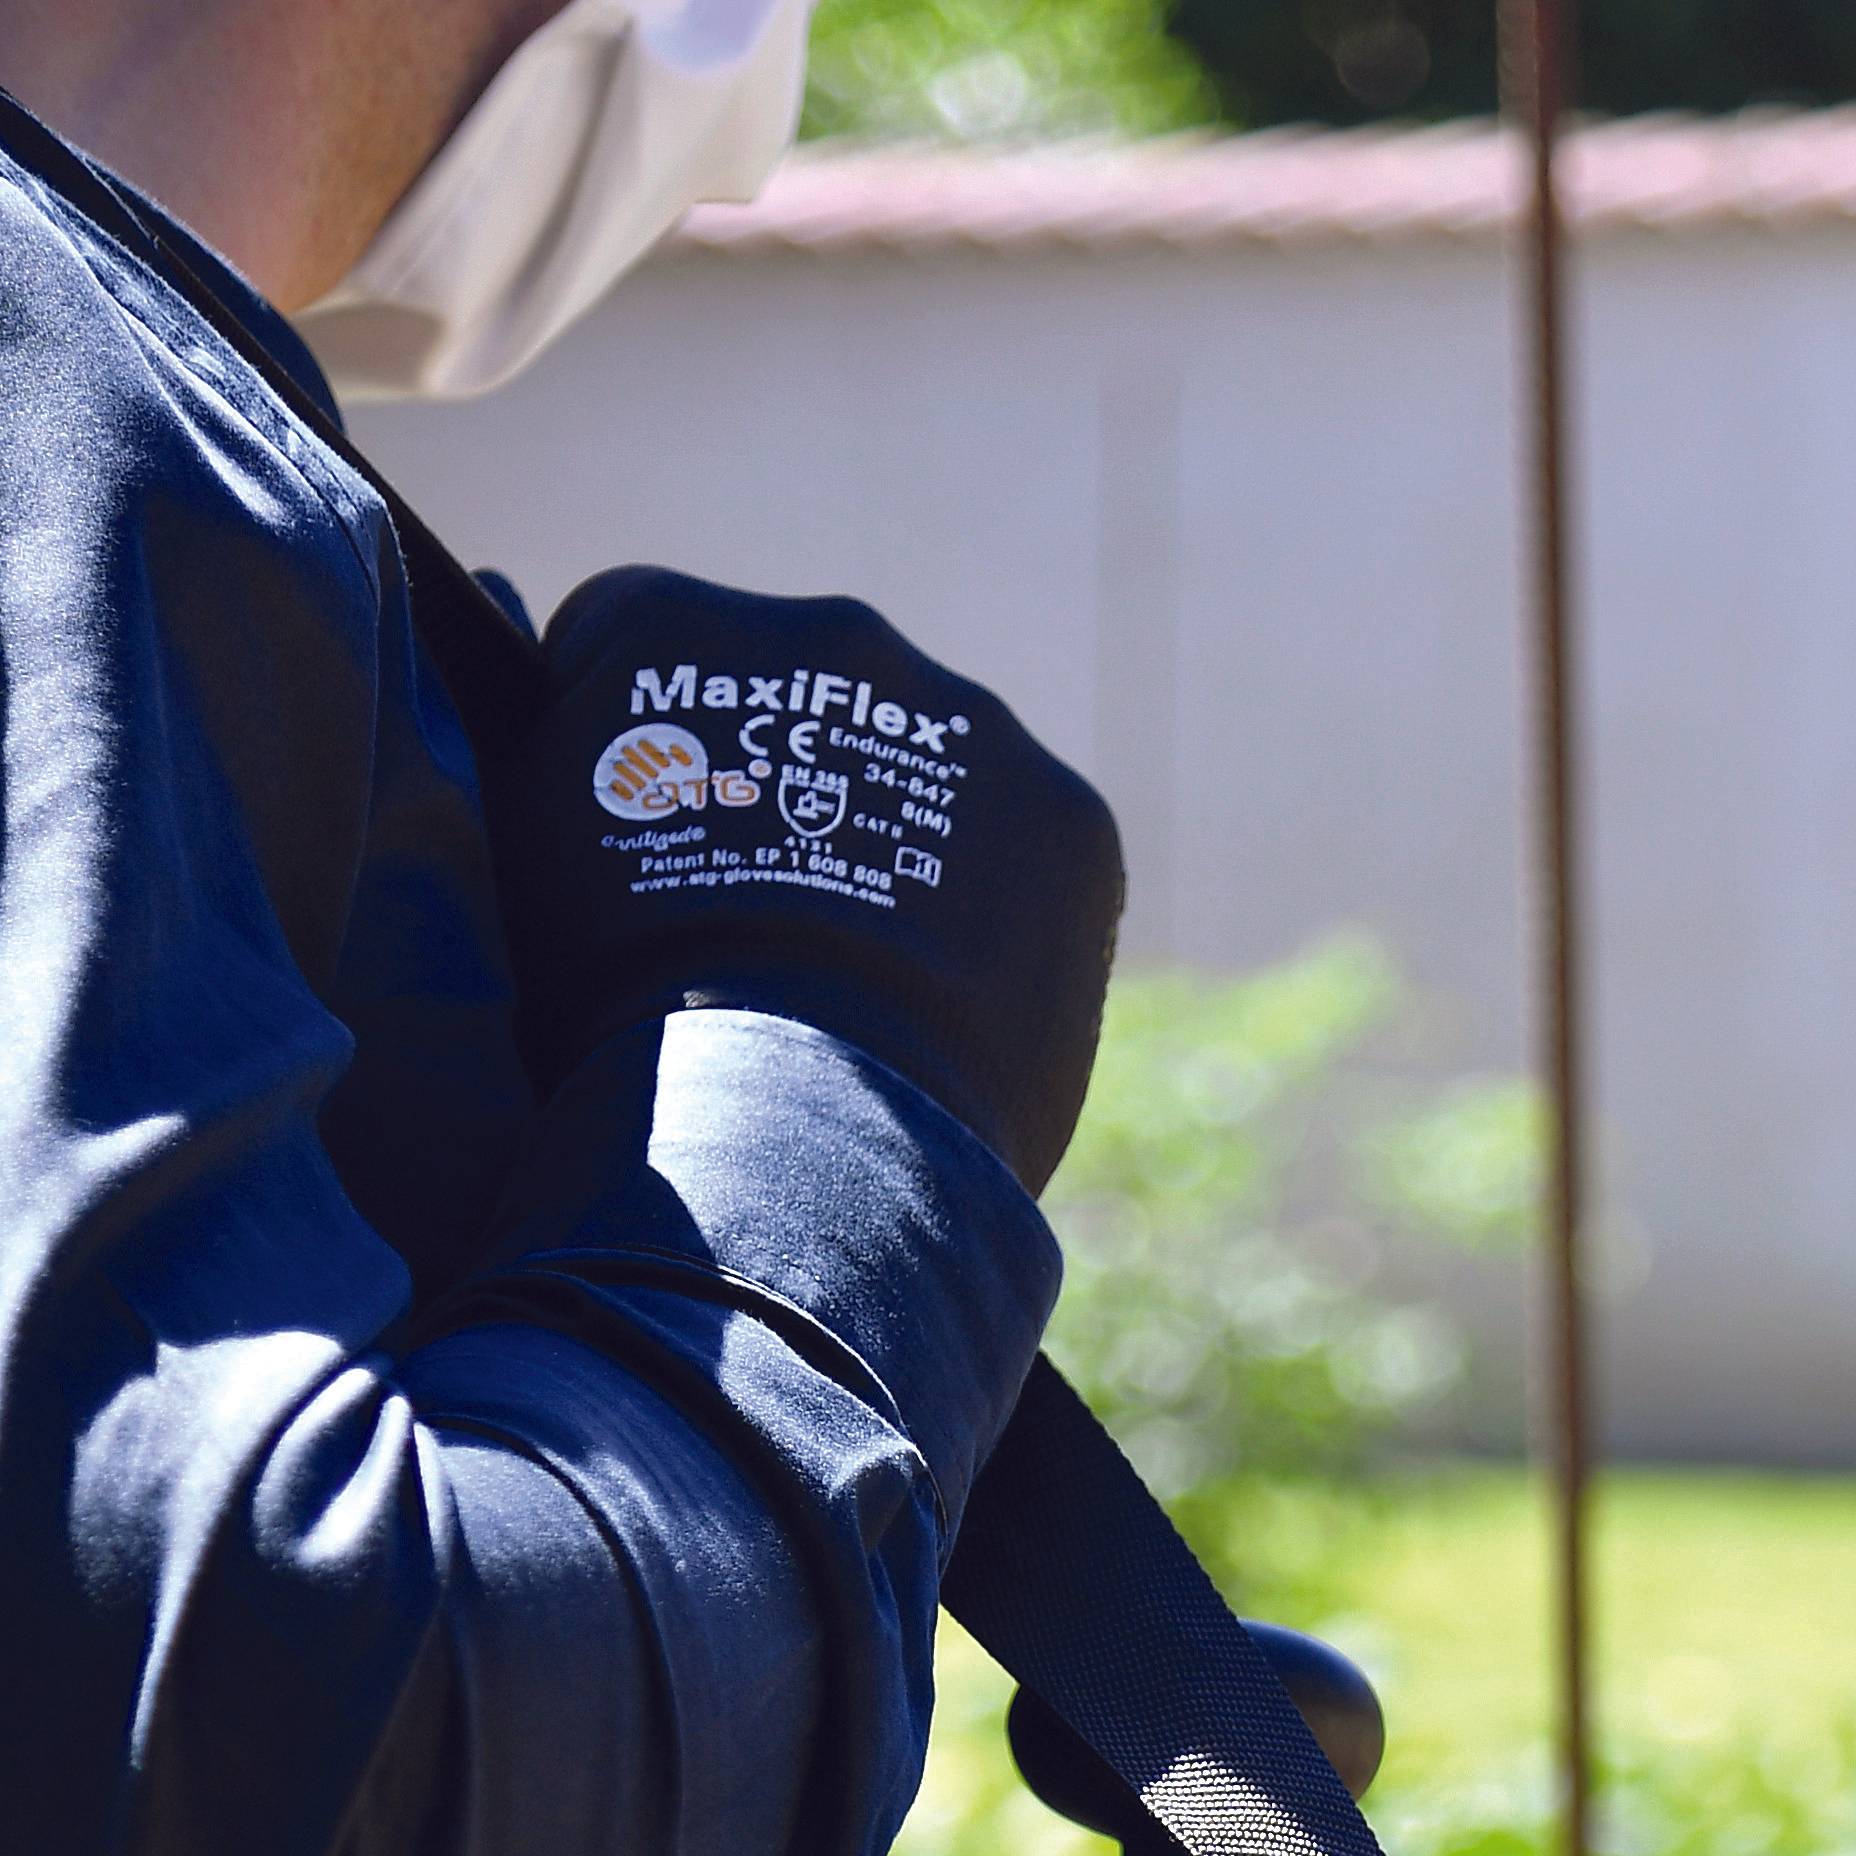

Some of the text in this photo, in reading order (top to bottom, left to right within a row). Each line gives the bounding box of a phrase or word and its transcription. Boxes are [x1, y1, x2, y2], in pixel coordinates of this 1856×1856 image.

[853, 813, 888, 834] CAT
[641, 852, 705, 873] Patent
[712, 849, 746, 866] No.
[755, 848, 781, 866] EP
[790, 850, 800, 868] 1
